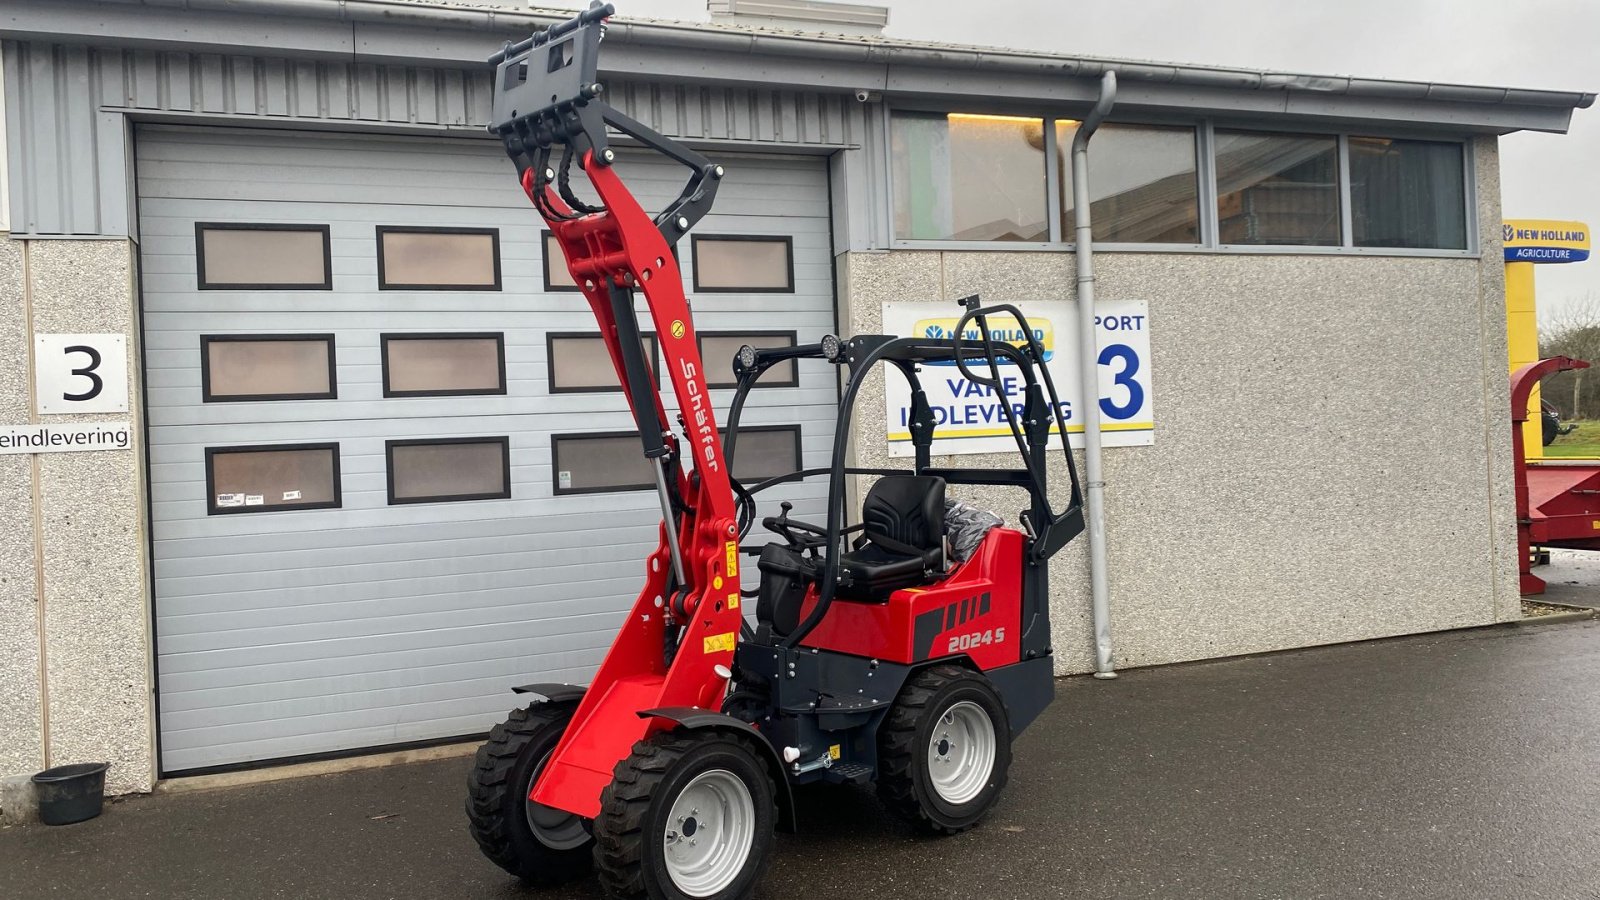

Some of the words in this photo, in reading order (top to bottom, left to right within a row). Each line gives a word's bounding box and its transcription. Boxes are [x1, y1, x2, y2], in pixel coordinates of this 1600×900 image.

[1517, 229, 1539, 240] NEW
[1541, 230, 1585, 242] HOLLAND
[1516, 248, 1570, 259] AGRICULTURE
[63, 345, 104, 402] 3
[1097, 343, 1145, 420] 3
[680, 358, 719, 473] Schäffer
[901, 401, 1072, 427] IDLEVERG
[0, 426, 128, 448] eindlevering
[948, 629, 993, 653] 2024
[994, 627, 1006, 643] S
